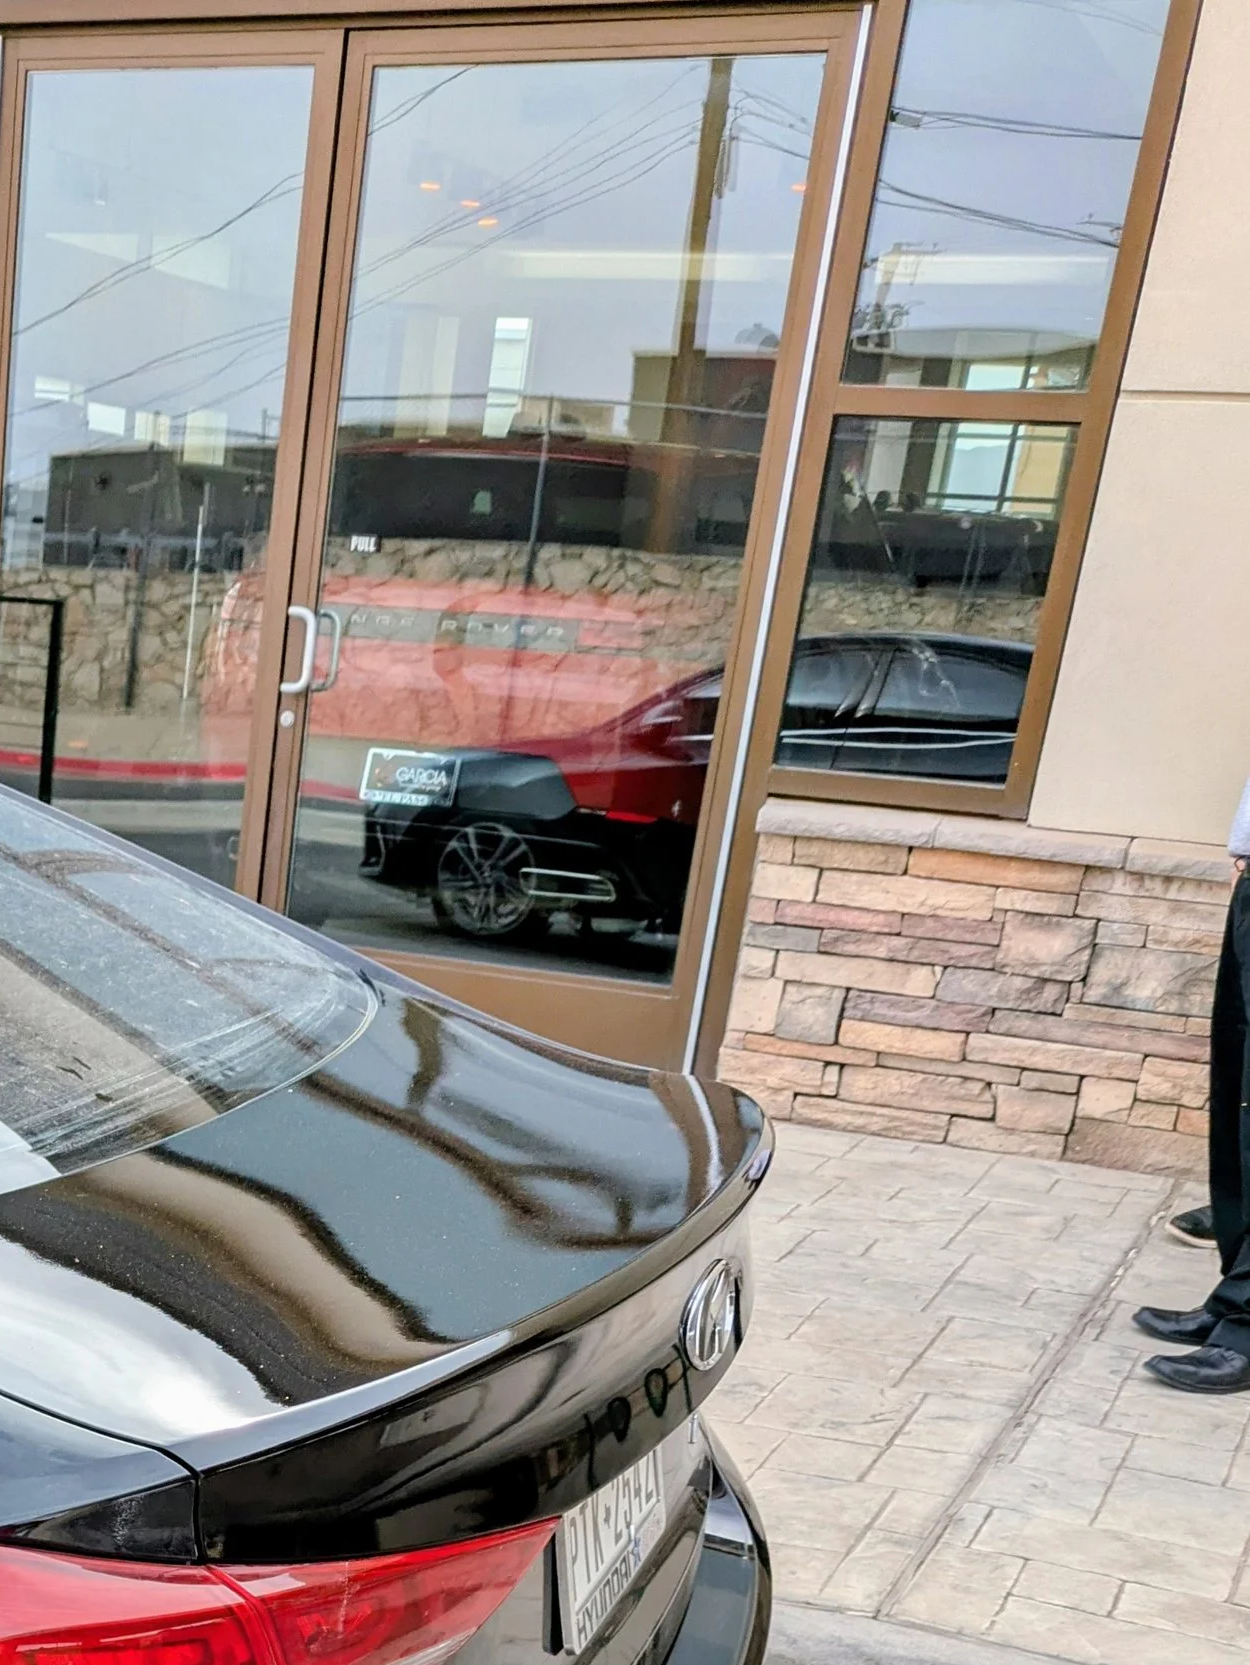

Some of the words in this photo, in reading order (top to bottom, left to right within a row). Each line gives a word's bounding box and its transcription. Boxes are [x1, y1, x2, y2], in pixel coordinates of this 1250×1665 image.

[350, 535, 377, 552] PULL
[396, 766, 448, 787] GARCIA
[576, 1549, 632, 1649] HYUNDAI
